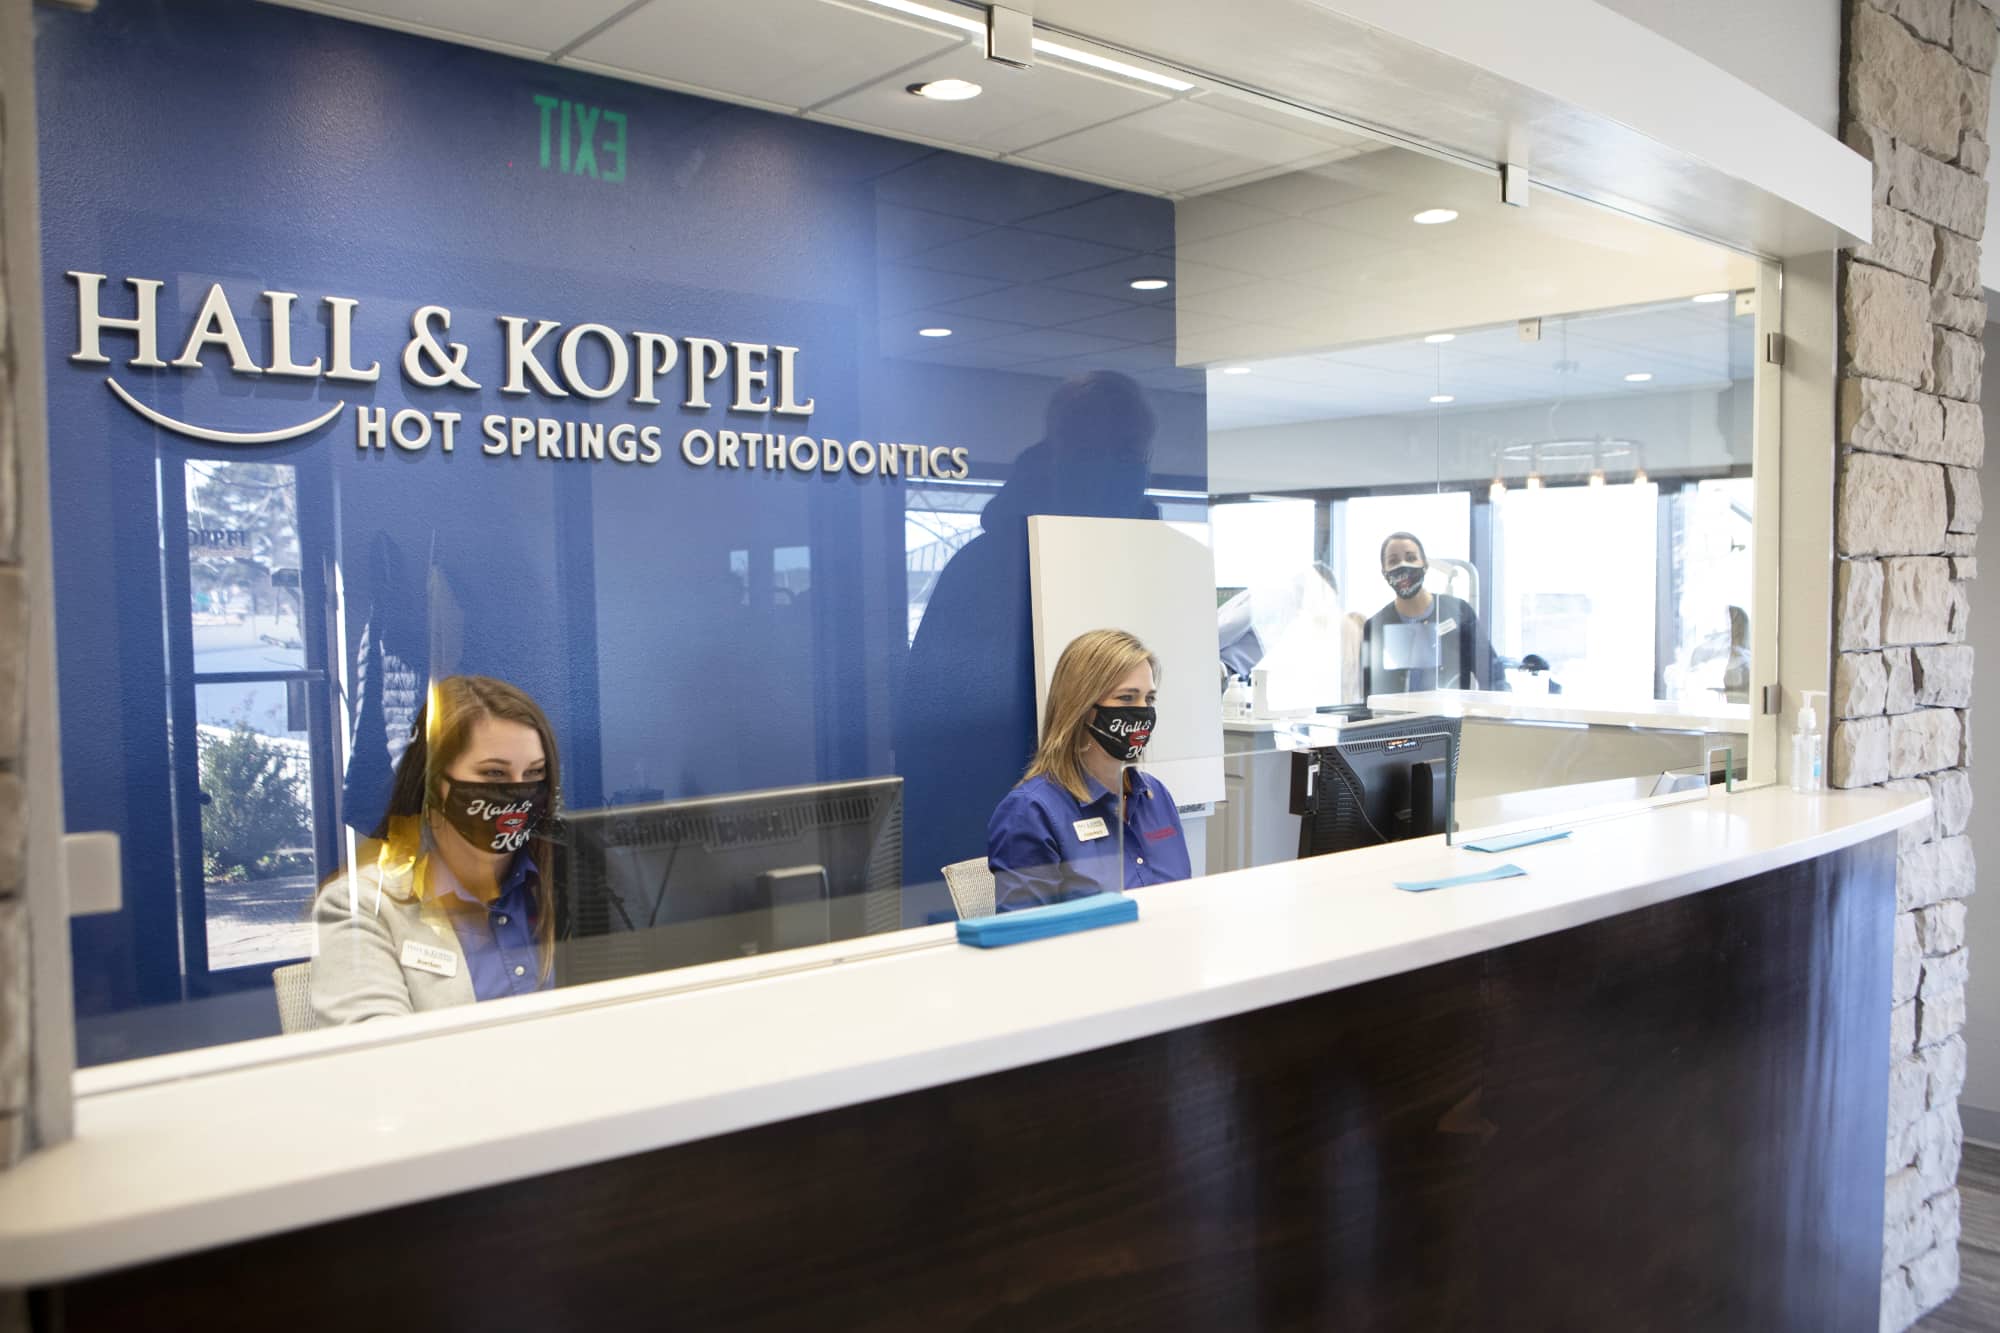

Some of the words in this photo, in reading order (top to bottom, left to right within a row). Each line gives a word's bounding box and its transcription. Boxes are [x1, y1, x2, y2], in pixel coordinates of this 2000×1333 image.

[66, 270, 381, 383] HALL
[402, 304, 482, 390] &
[499, 315, 815, 416] KOPPEL
[356, 404, 462, 452] HOT
[483, 414, 663, 464] SPRINGS
[681, 428, 970, 480] ORTHODONTICS
